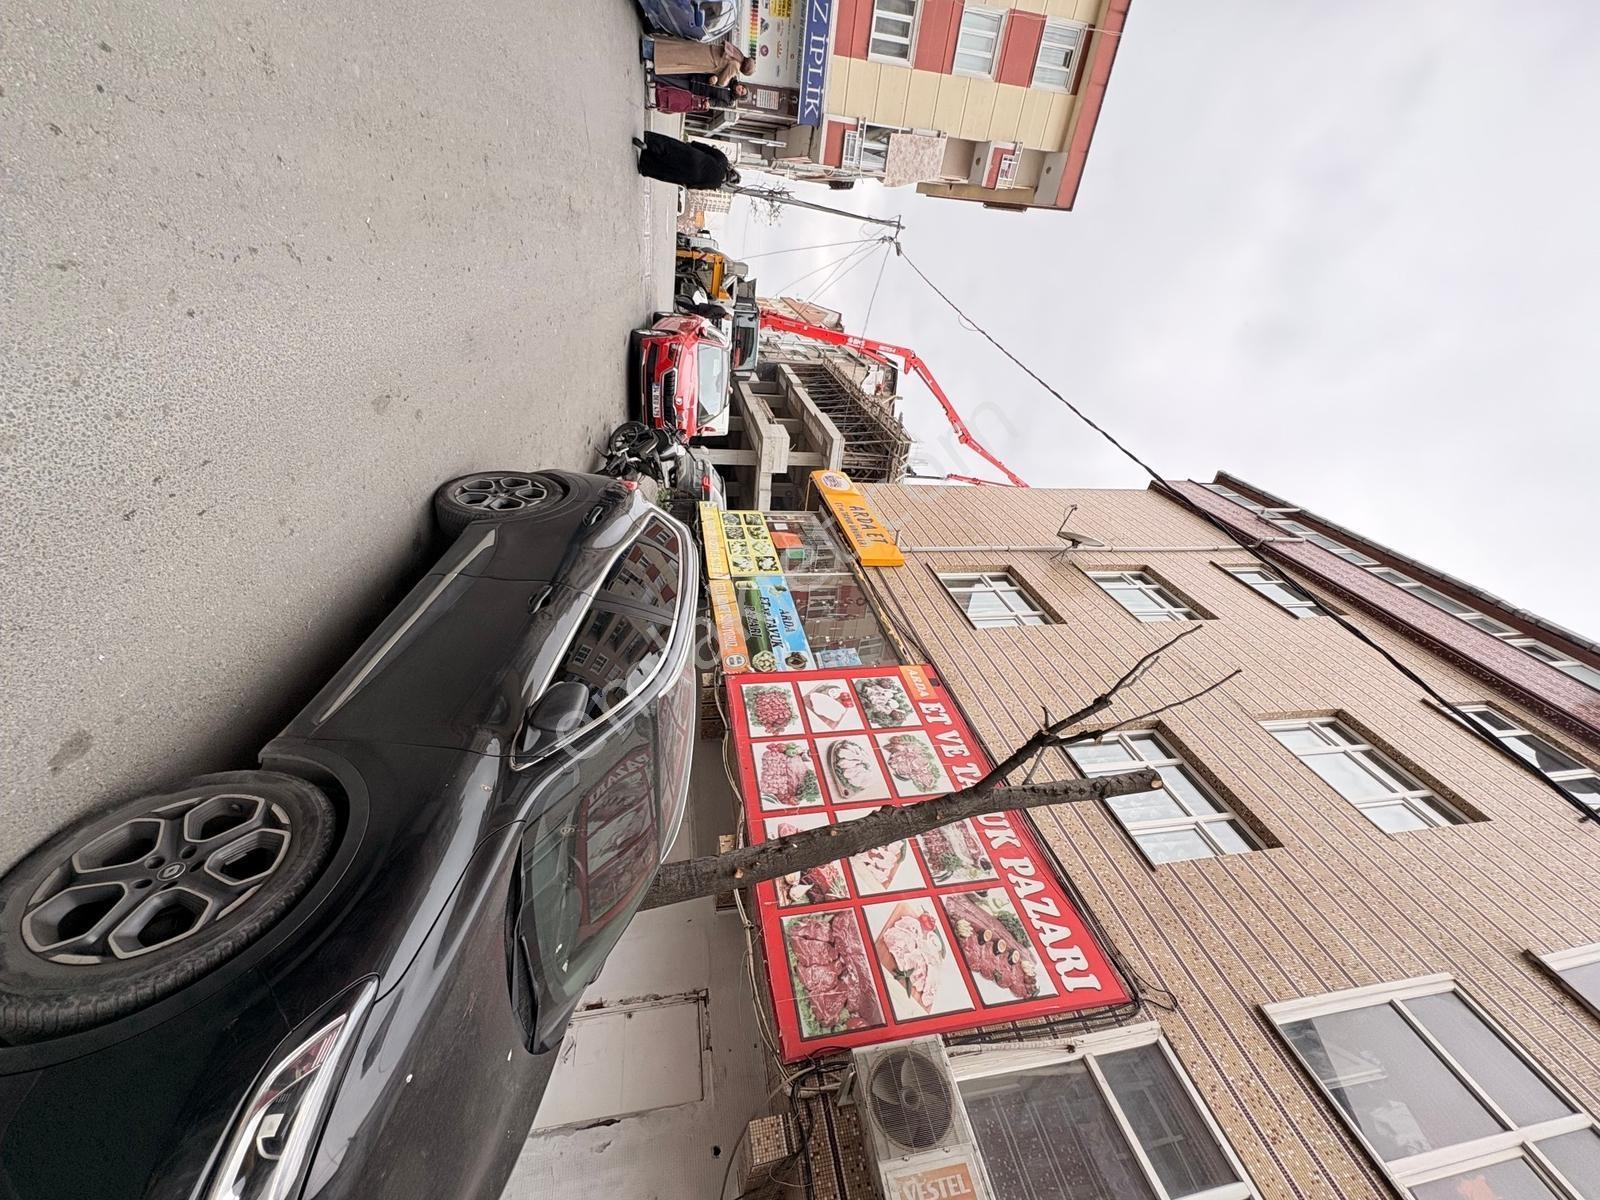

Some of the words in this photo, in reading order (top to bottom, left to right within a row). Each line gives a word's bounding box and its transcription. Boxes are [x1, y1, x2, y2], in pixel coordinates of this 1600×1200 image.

[804, 33, 829, 118] İPLİK
[849, 506, 878, 530] ARDA
[866, 533, 889, 544] ET
[759, 596, 771, 606] ET
[743, 604, 762, 638] PAZARI
[764, 618, 784, 648] TAVUK
[778, 608, 796, 632] ARDA
[906, 669, 929, 698] ARDA
[918, 701, 950, 726] ET
[936, 730, 968, 757] VE
[952, 763, 1021, 849] TAUK
[1000, 856, 1102, 993] PAZARI
